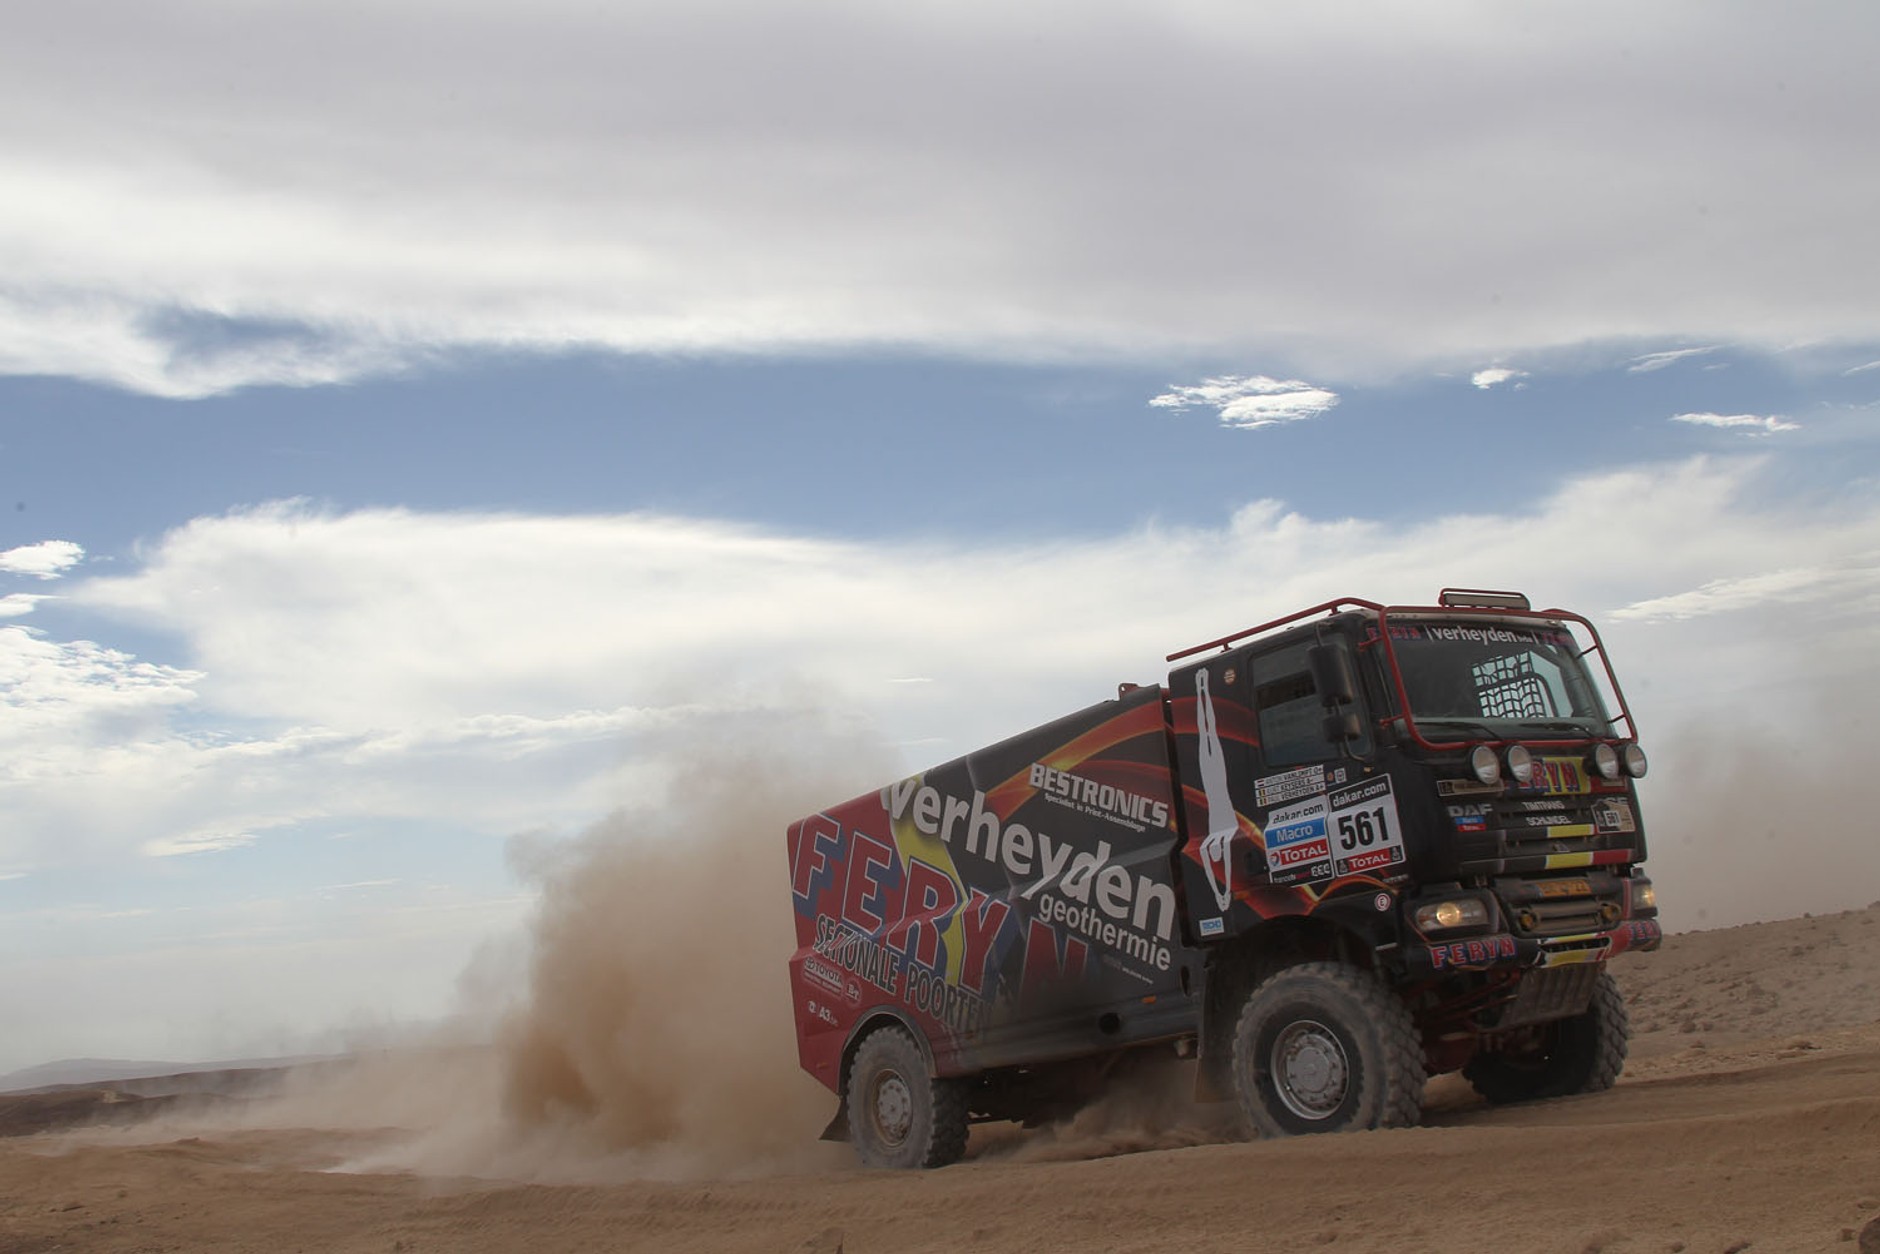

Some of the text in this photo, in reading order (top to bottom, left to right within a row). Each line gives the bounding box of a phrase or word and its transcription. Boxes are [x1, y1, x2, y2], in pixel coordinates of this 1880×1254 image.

[1432, 625, 1517, 646] verheyden
[1030, 763, 1168, 828] BESTRONICS
[1333, 783, 1387, 807] dakar.com
[1273, 804, 1324, 824] dakar.com
[1448, 803, 1494, 817] DAF
[1606, 811, 1620, 824] 561
[1276, 825, 1313, 843] Macro
[1338, 806, 1389, 851] 561
[888, 779, 1176, 941] verheyden
[1281, 844, 1327, 862] TOTAL
[1350, 854, 1389, 870] TOTAL
[793, 813, 1089, 1003] FERYN
[1038, 894, 1172, 972] geothermie
[1430, 937, 1515, 969] FERYN
